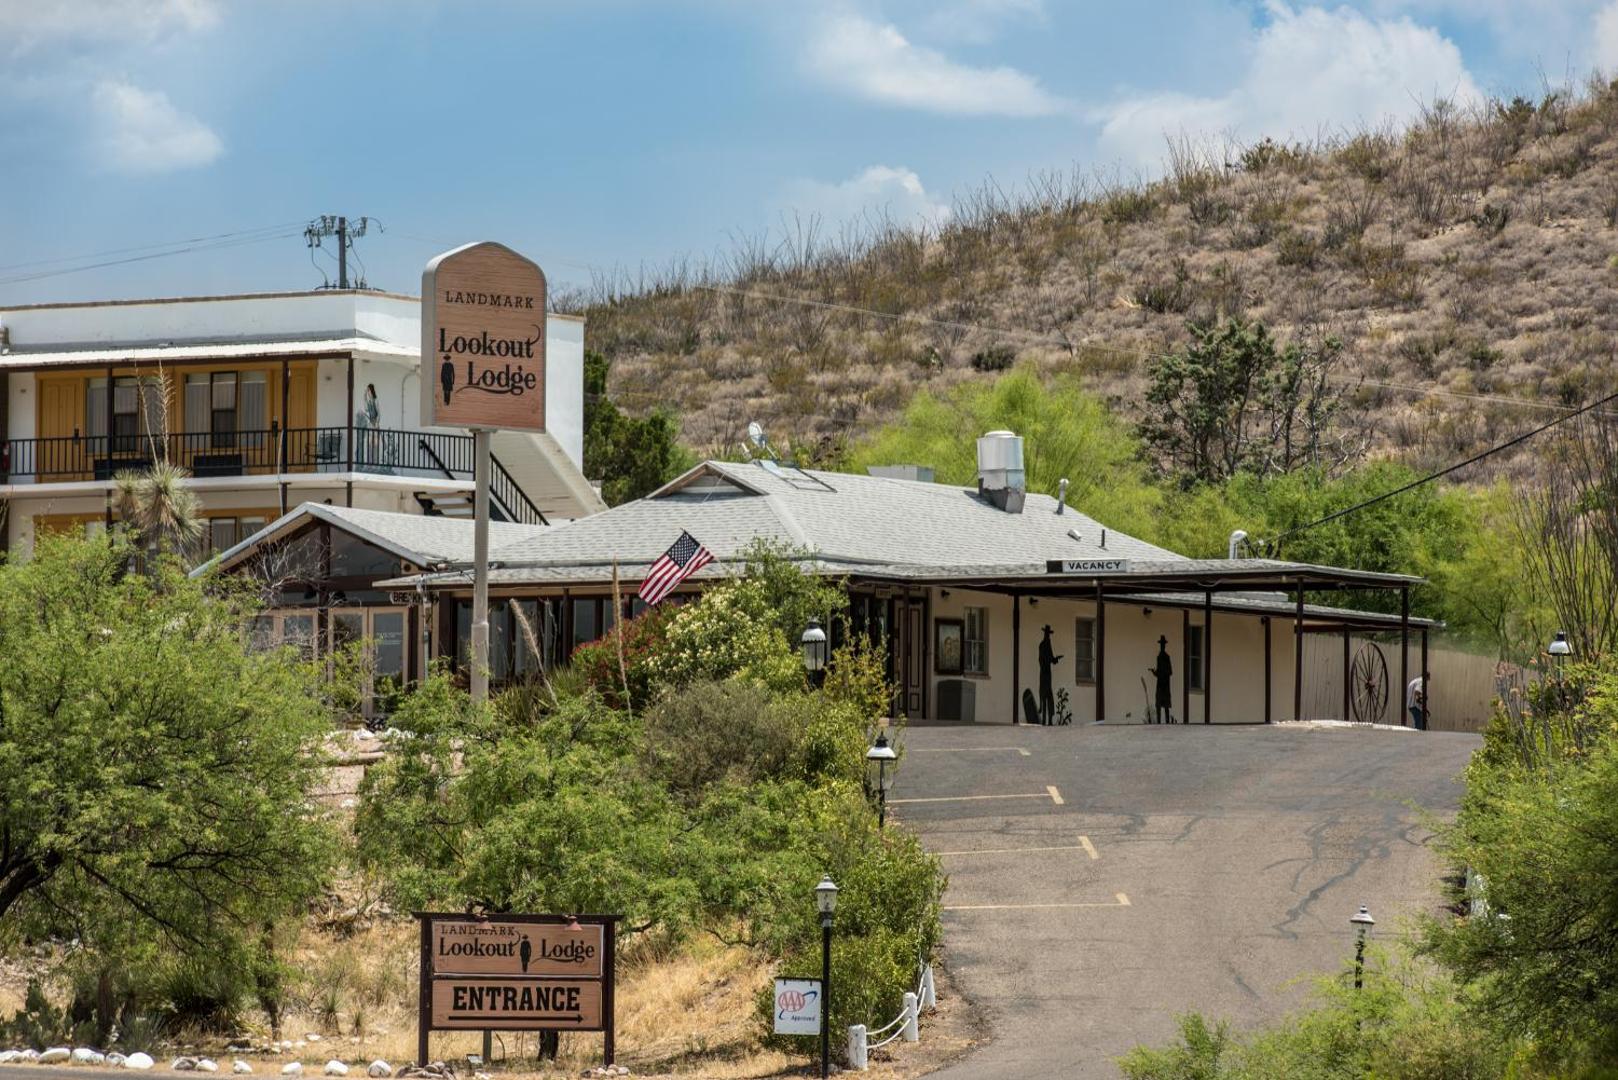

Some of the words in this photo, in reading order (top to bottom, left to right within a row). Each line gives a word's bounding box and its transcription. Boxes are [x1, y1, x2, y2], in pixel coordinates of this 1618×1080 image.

[445, 290, 534, 309] LANDMARK
[438, 324, 541, 359] Lookout
[456, 361, 537, 396] Lodge
[1068, 561, 1121, 570] VACANCY
[439, 930, 521, 957] Lookout
[532, 938, 595, 963] Lodge
[452, 986, 581, 1011] ENTRANCE
[780, 991, 804, 1010] AAA
